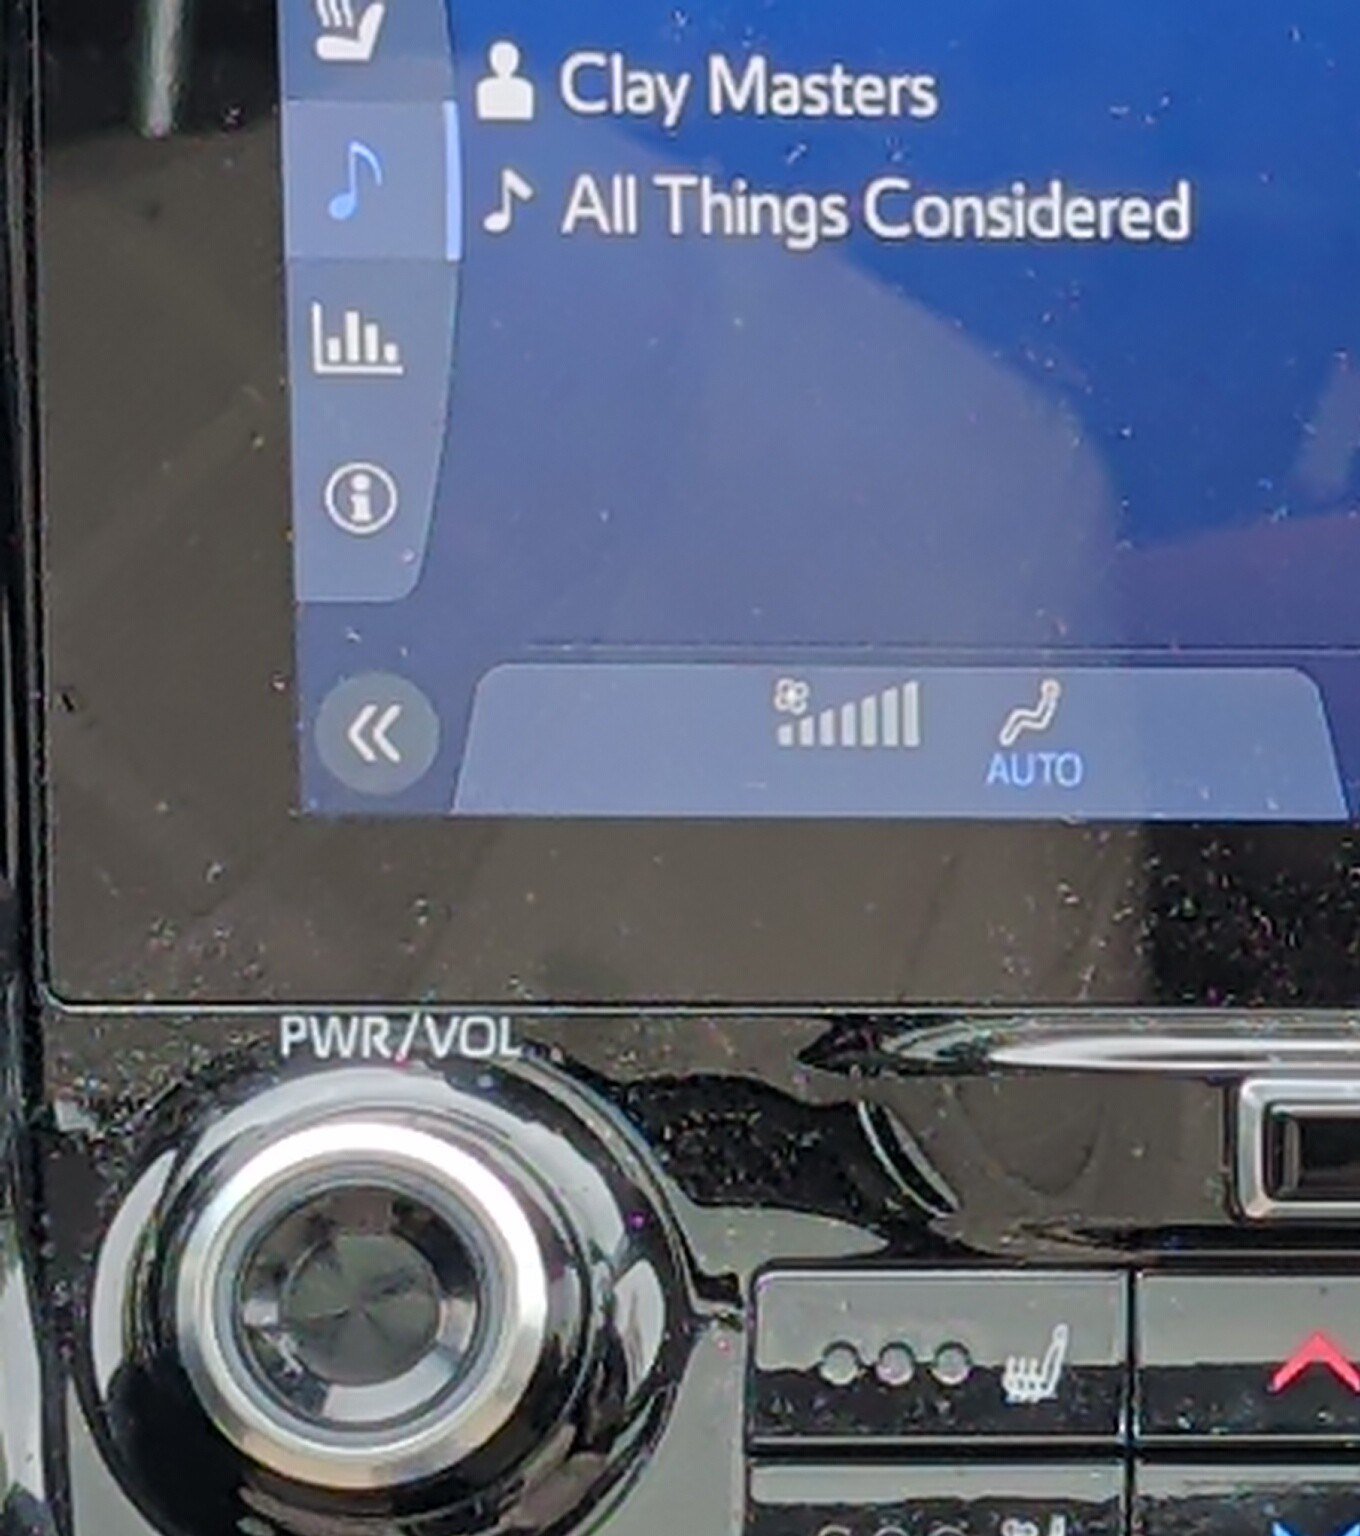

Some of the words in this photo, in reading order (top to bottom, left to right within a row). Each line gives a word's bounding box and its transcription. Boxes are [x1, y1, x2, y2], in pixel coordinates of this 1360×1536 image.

[560, 53, 688, 125] Clay
[709, 55, 938, 118] Masters
[562, 176, 637, 236] All
[655, 176, 849, 250] Things
[865, 180, 1190, 242] Considered
[987, 752, 1083, 788] AUTO
[280, 1013, 521, 1057] PWR/VOL
